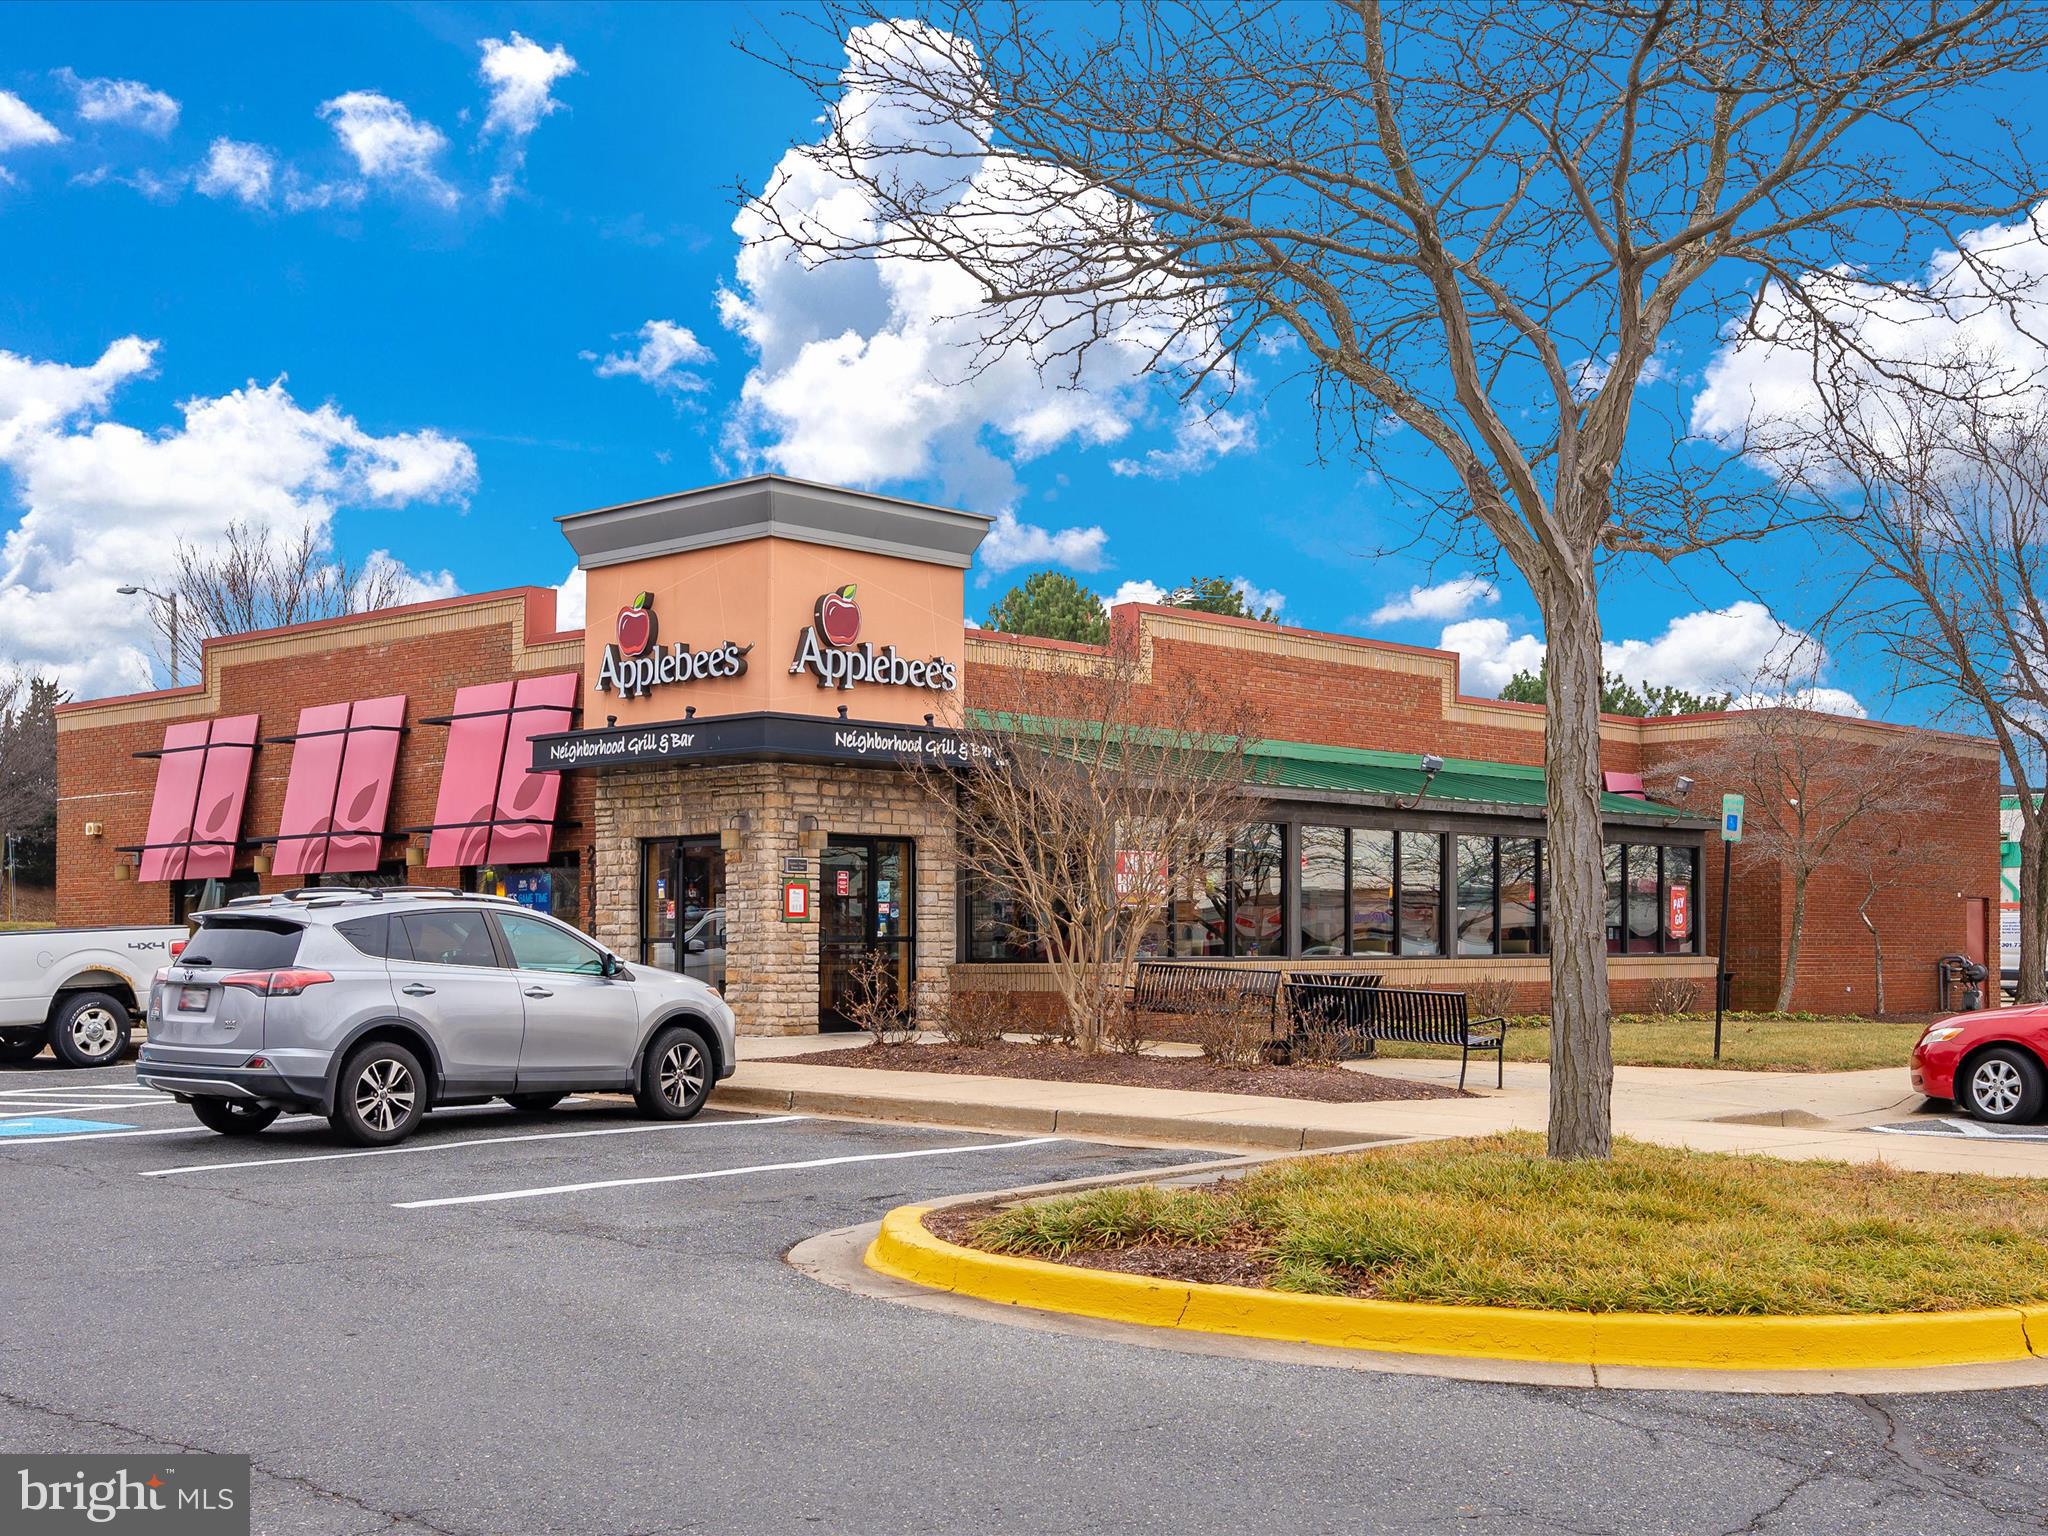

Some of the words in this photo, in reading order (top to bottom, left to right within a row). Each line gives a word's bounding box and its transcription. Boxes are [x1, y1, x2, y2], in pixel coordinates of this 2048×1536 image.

[595, 640, 744, 698] Applebee's
[790, 624, 958, 691] Applebee's
[550, 736, 625, 762] Neighborhood
[627, 733, 657, 755] Grill
[658, 733, 669, 753] &
[670, 733, 695, 748] Bar
[835, 730, 923, 753] Neighborhood
[925, 738, 956, 757] Grill
[958, 742, 968, 760] &
[1673, 897, 1684, 910] PAY
[1674, 913, 1683, 925] GO
[128, 941, 165, 950] 4X4
